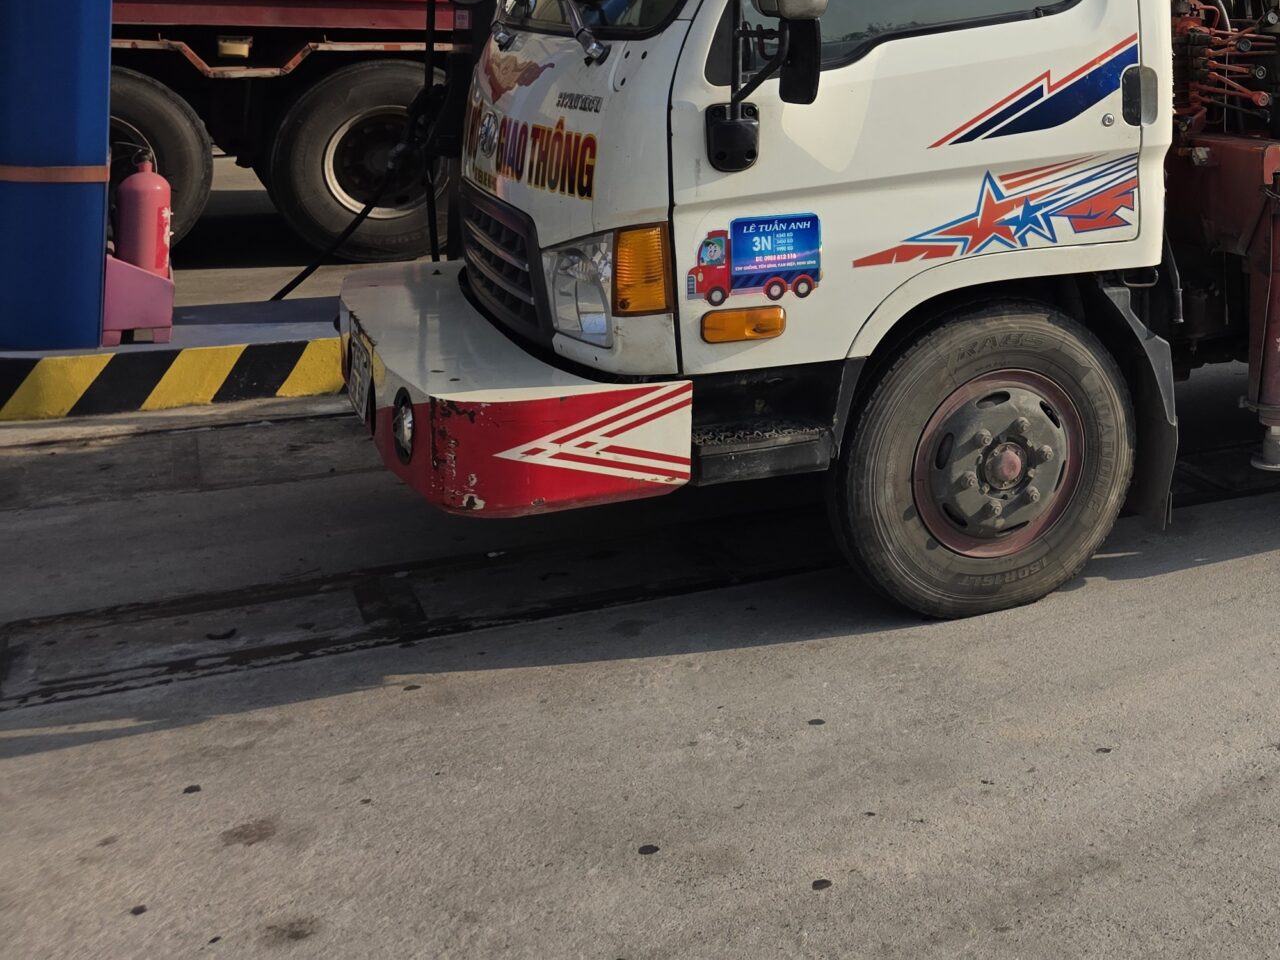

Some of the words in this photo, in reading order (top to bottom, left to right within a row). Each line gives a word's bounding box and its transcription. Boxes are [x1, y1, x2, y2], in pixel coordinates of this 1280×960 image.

[496, 114, 529, 184] GIAO
[527, 115, 597, 202] THÔNG
[788, 221, 811, 230] ANH
[752, 235, 772, 252] 3N
